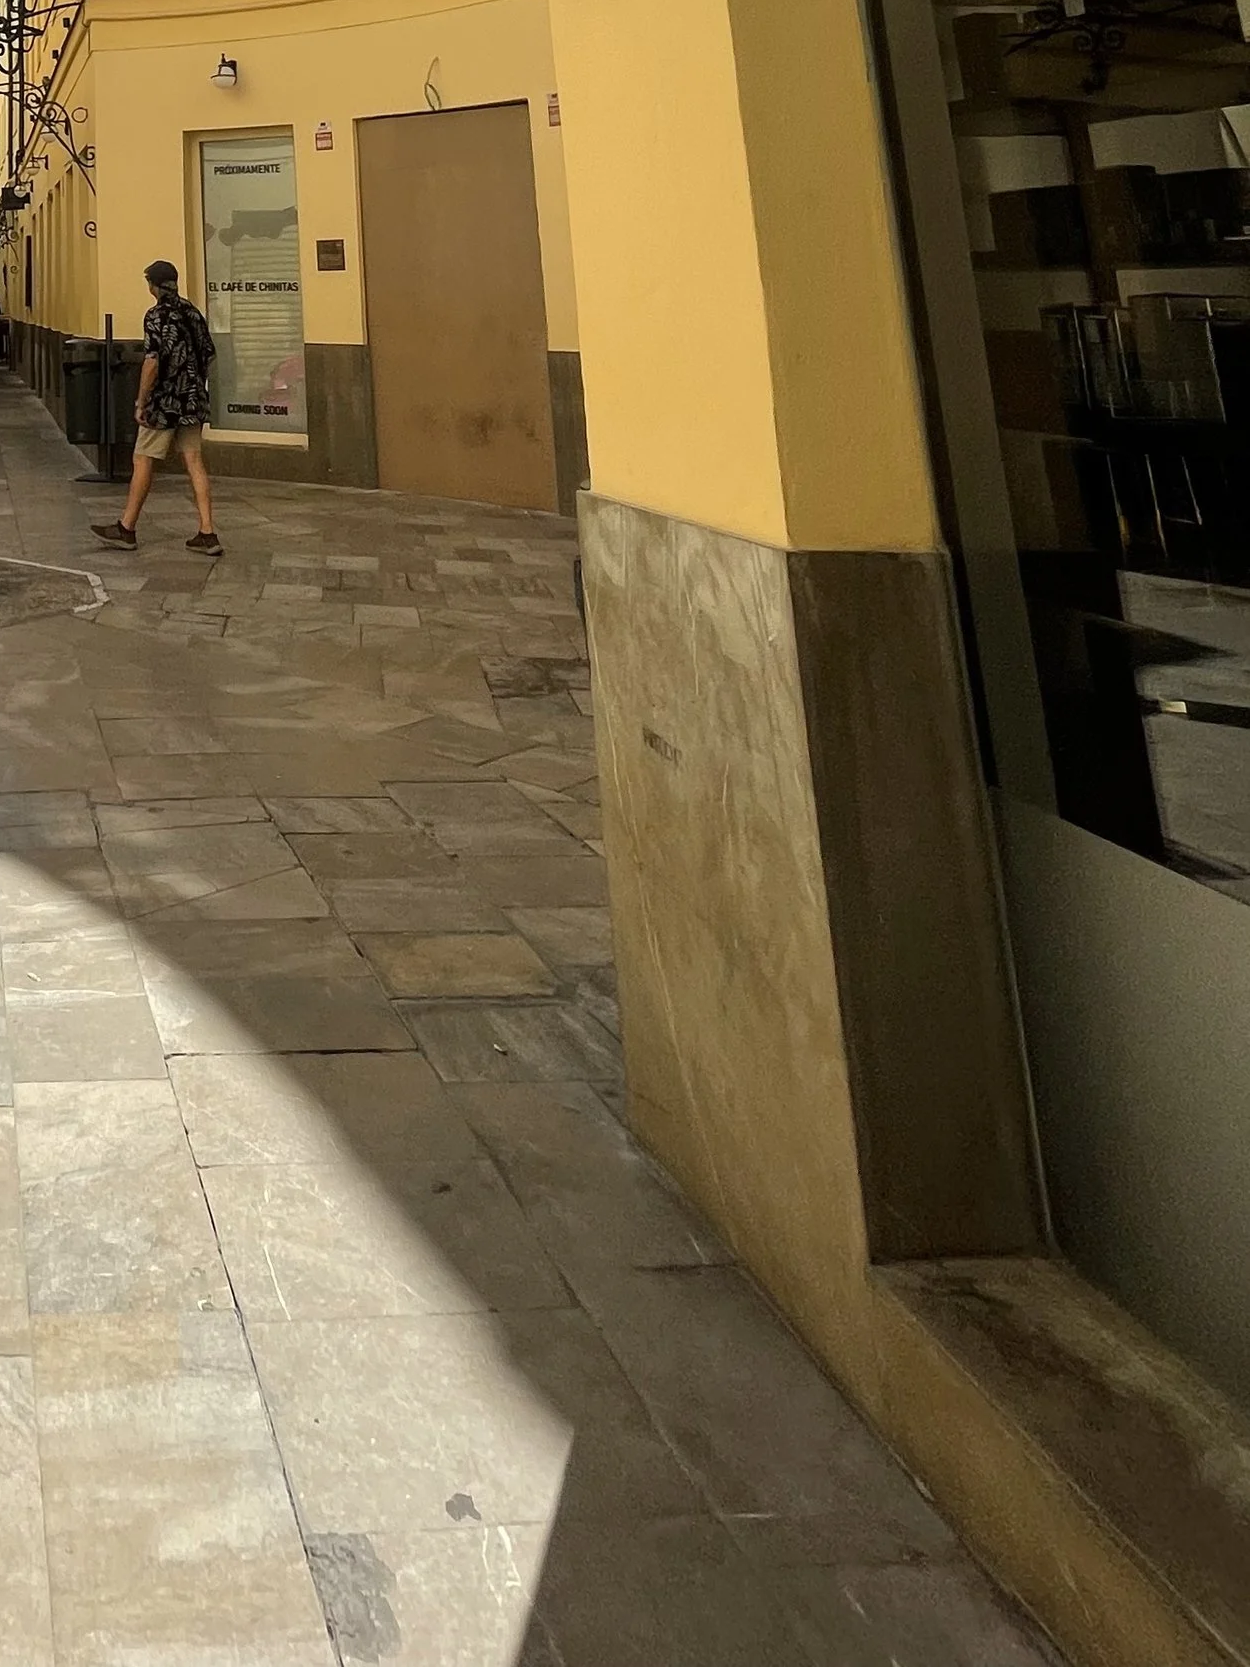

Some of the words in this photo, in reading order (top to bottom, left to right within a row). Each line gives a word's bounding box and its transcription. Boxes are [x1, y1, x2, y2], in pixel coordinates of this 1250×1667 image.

[209, 282, 219, 292] EL
[221, 279, 243, 292] CAFÉ
[245, 282, 257, 292] DE
[258, 281, 299, 292] CHINITAS
[227, 404, 261, 415] COMING
[263, 404, 288, 415] SOON
